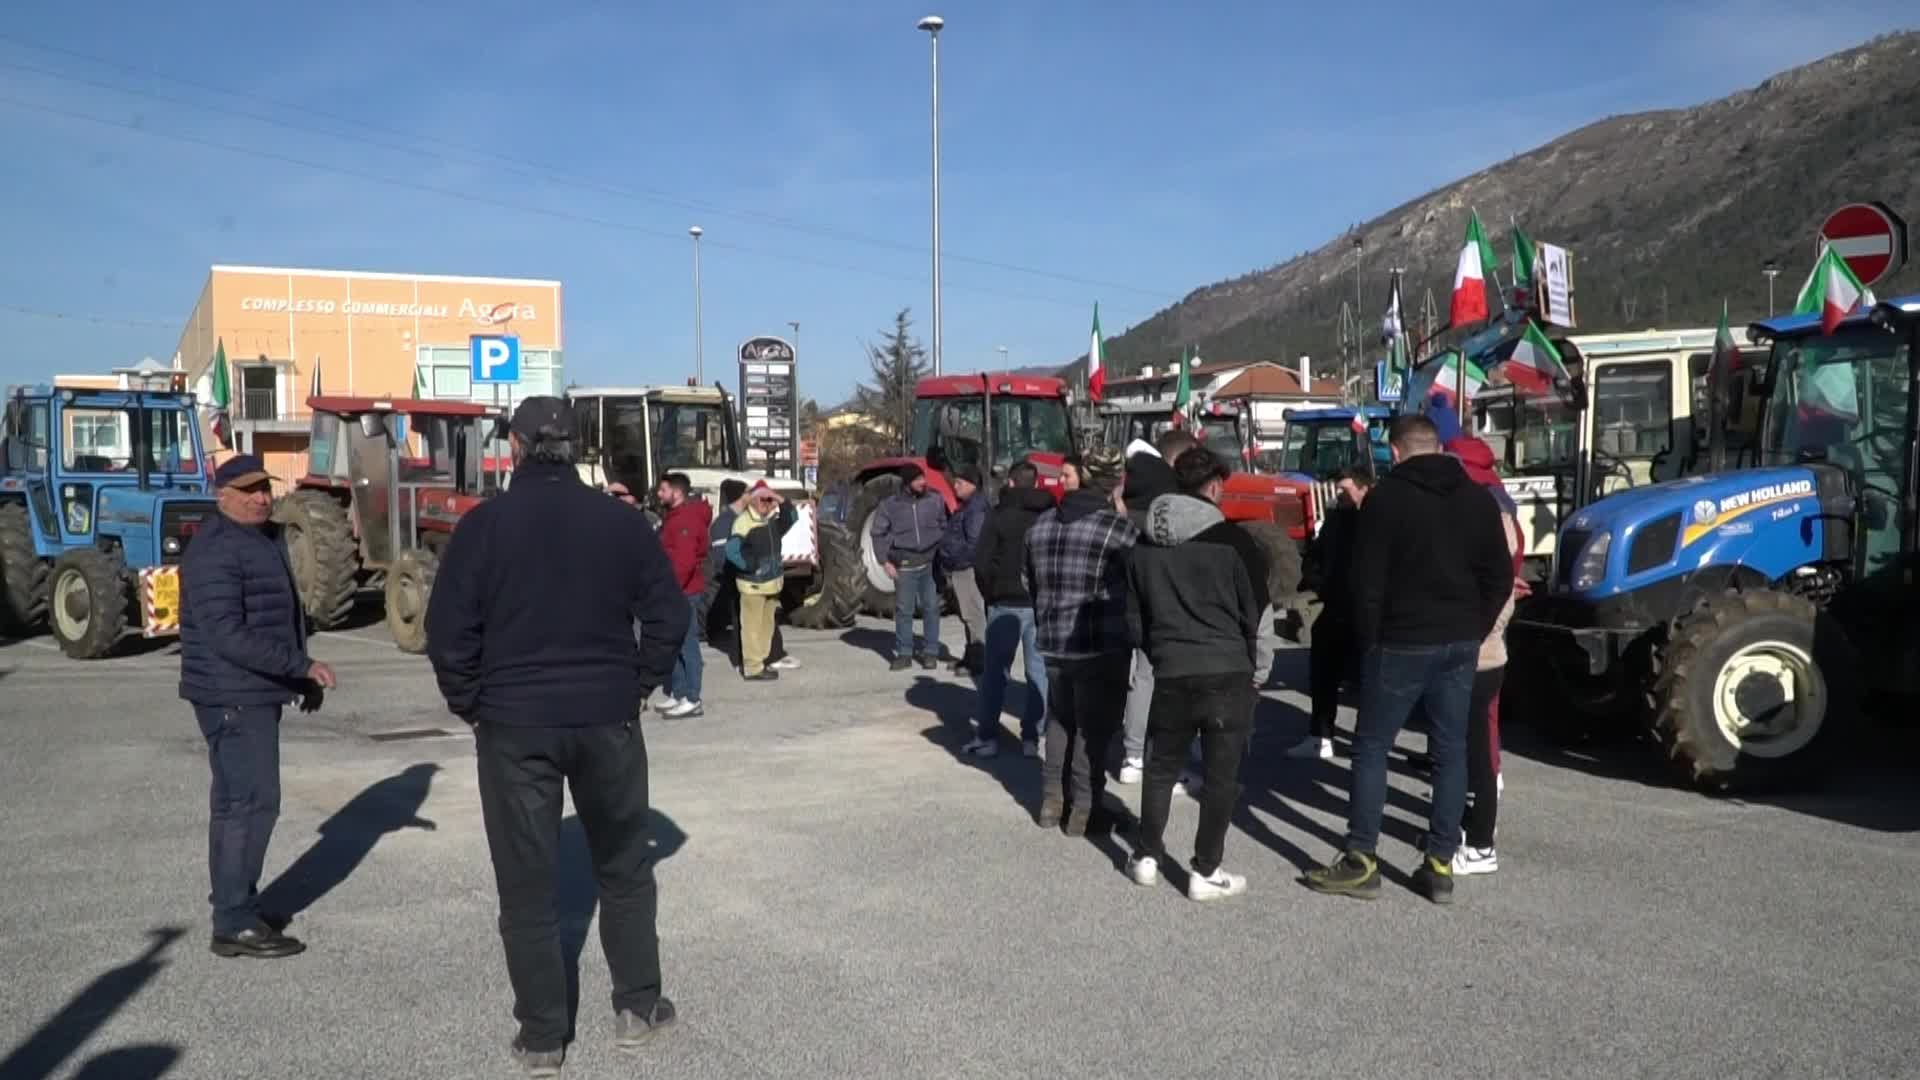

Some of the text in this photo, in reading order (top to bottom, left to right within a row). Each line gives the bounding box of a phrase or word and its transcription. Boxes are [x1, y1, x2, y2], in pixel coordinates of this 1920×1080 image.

[241, 297, 336, 313] COMPLESSO
[342, 301, 448, 317] COMMERCIALE
[480, 339, 510, 379] P
[1720, 492, 1749, 512] NEW
[1751, 480, 1811, 502] HOLLAND
